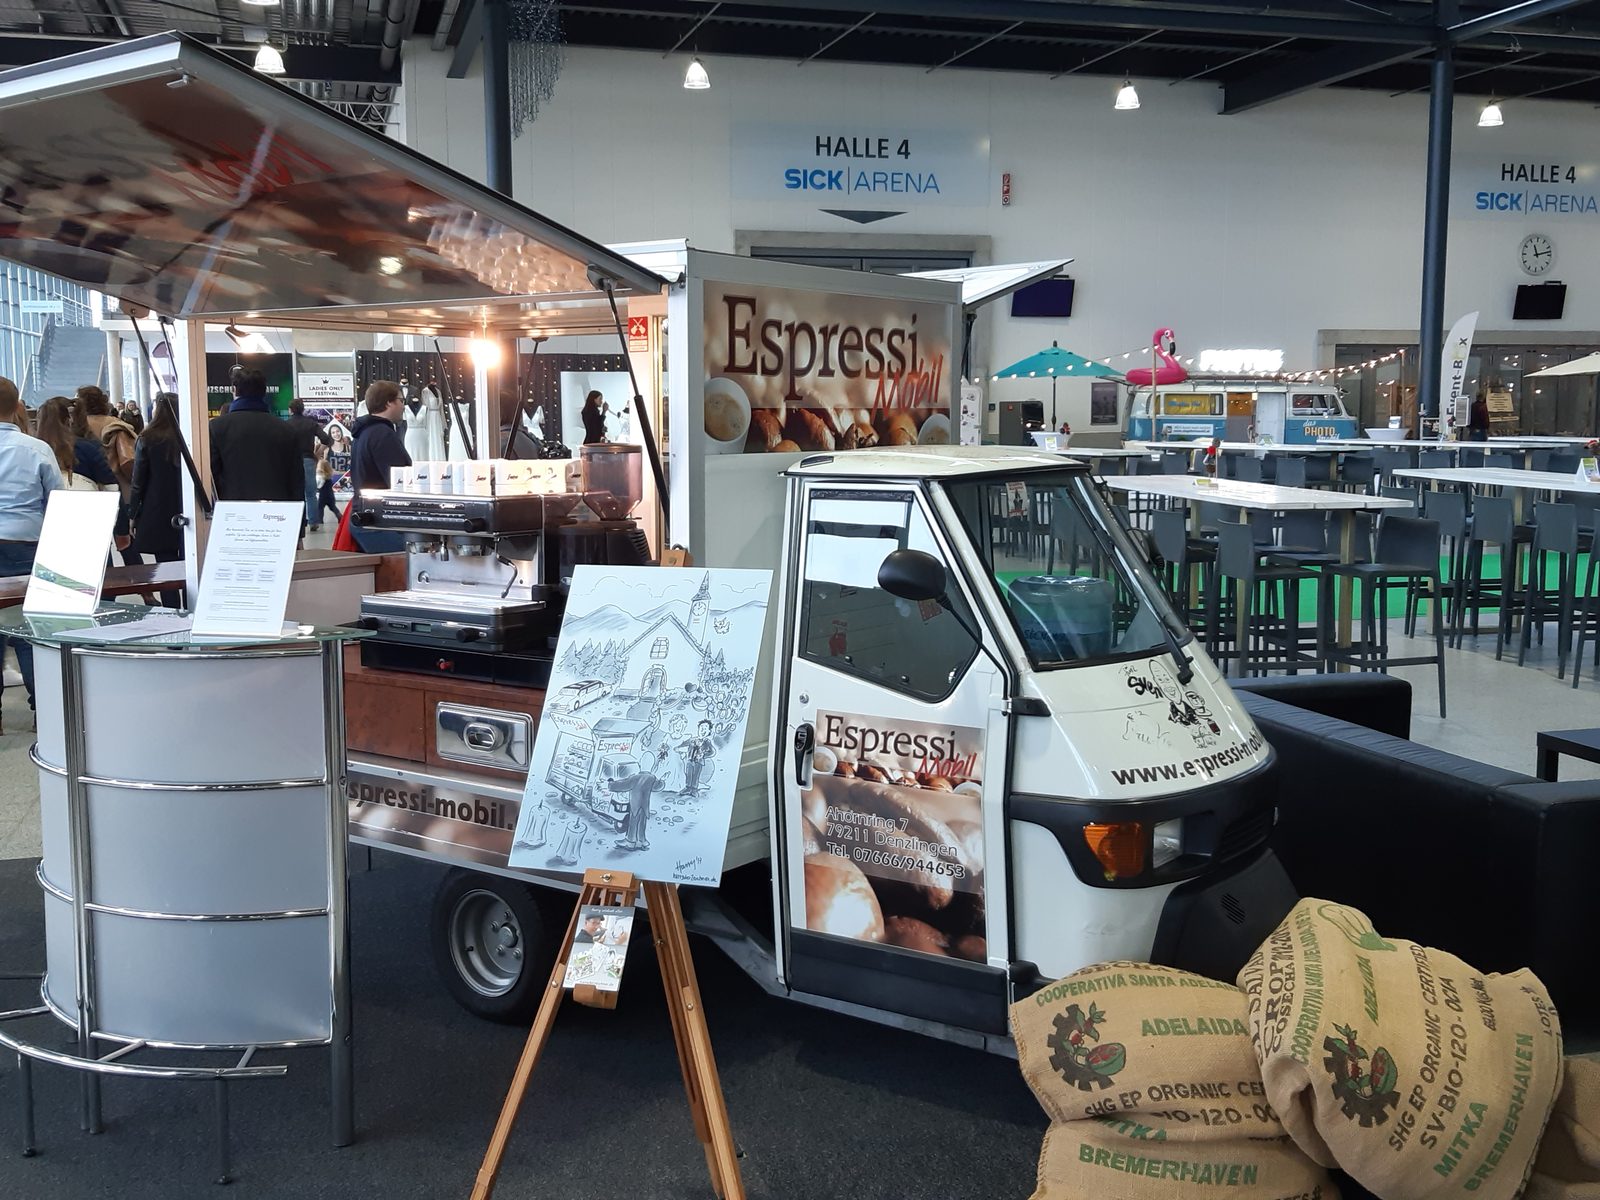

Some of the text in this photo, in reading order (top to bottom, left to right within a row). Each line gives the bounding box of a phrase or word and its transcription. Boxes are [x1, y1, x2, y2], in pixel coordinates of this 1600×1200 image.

[816, 135, 911, 159] HALLE 4
[784, 168, 940, 194] SICK ARENA
[1501, 163, 1576, 184] HALLE 4
[1475, 191, 1598, 214] SICK ARENA
[722, 293, 919, 401] Espressi
[1304, 426, 1336, 436] PHOTO
[823, 714, 957, 764] Espressi
[914, 752, 977, 779] Mobil
[825, 806, 909, 831] Ahornring 7
[826, 822, 958, 858] 79211 Denzlingen
[826, 842, 966, 879] Tel. 07666/944653
[1035, 973, 1128, 1007] COOPERATIVA
[1129, 974, 1176, 988] SANTA
[1273, 961, 1296, 1053] COSECHA
[1141, 1017, 1249, 1037] ADELAIDA
[1263, 961, 1284, 1059] CROP
[1290, 988, 1324, 1066] COOPERATIVA
[1388, 944, 1442, 1151] SHG EP ORGANIC CERTIFIED
[1085, 1098, 1117, 1117] SHG
[1119, 1091, 1142, 1109] EP
[1147, 1082, 1232, 1102] ORGANIC
[1463, 1033, 1534, 1191] BREMERHAVEN
[1433, 1102, 1488, 1178] MITKA
[1079, 1143, 1258, 1185] BREMERHAVEN
